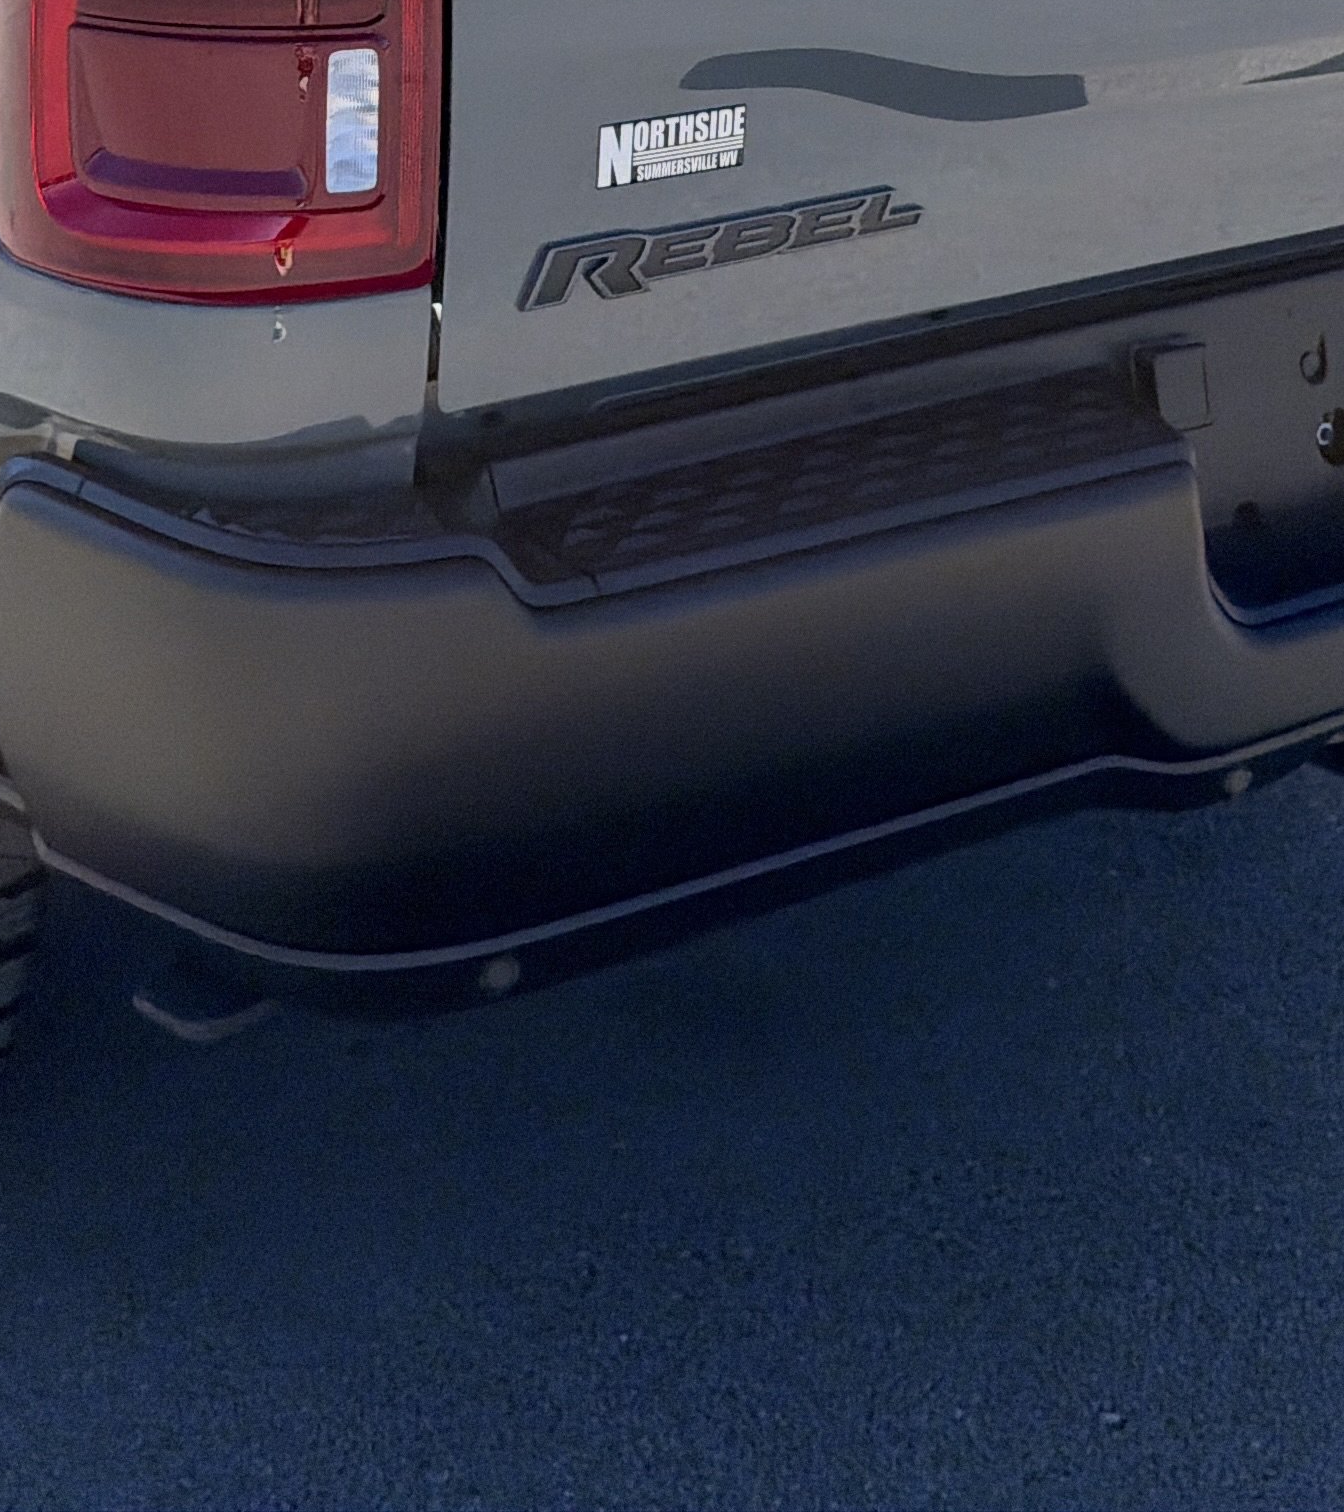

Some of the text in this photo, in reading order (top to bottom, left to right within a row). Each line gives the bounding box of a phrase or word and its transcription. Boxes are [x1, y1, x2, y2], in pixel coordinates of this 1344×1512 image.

[597, 106, 746, 188] NORTHSIDE
[636, 150, 738, 182] SUMMERSVILLE WV
[516, 184, 924, 312] REBEL
